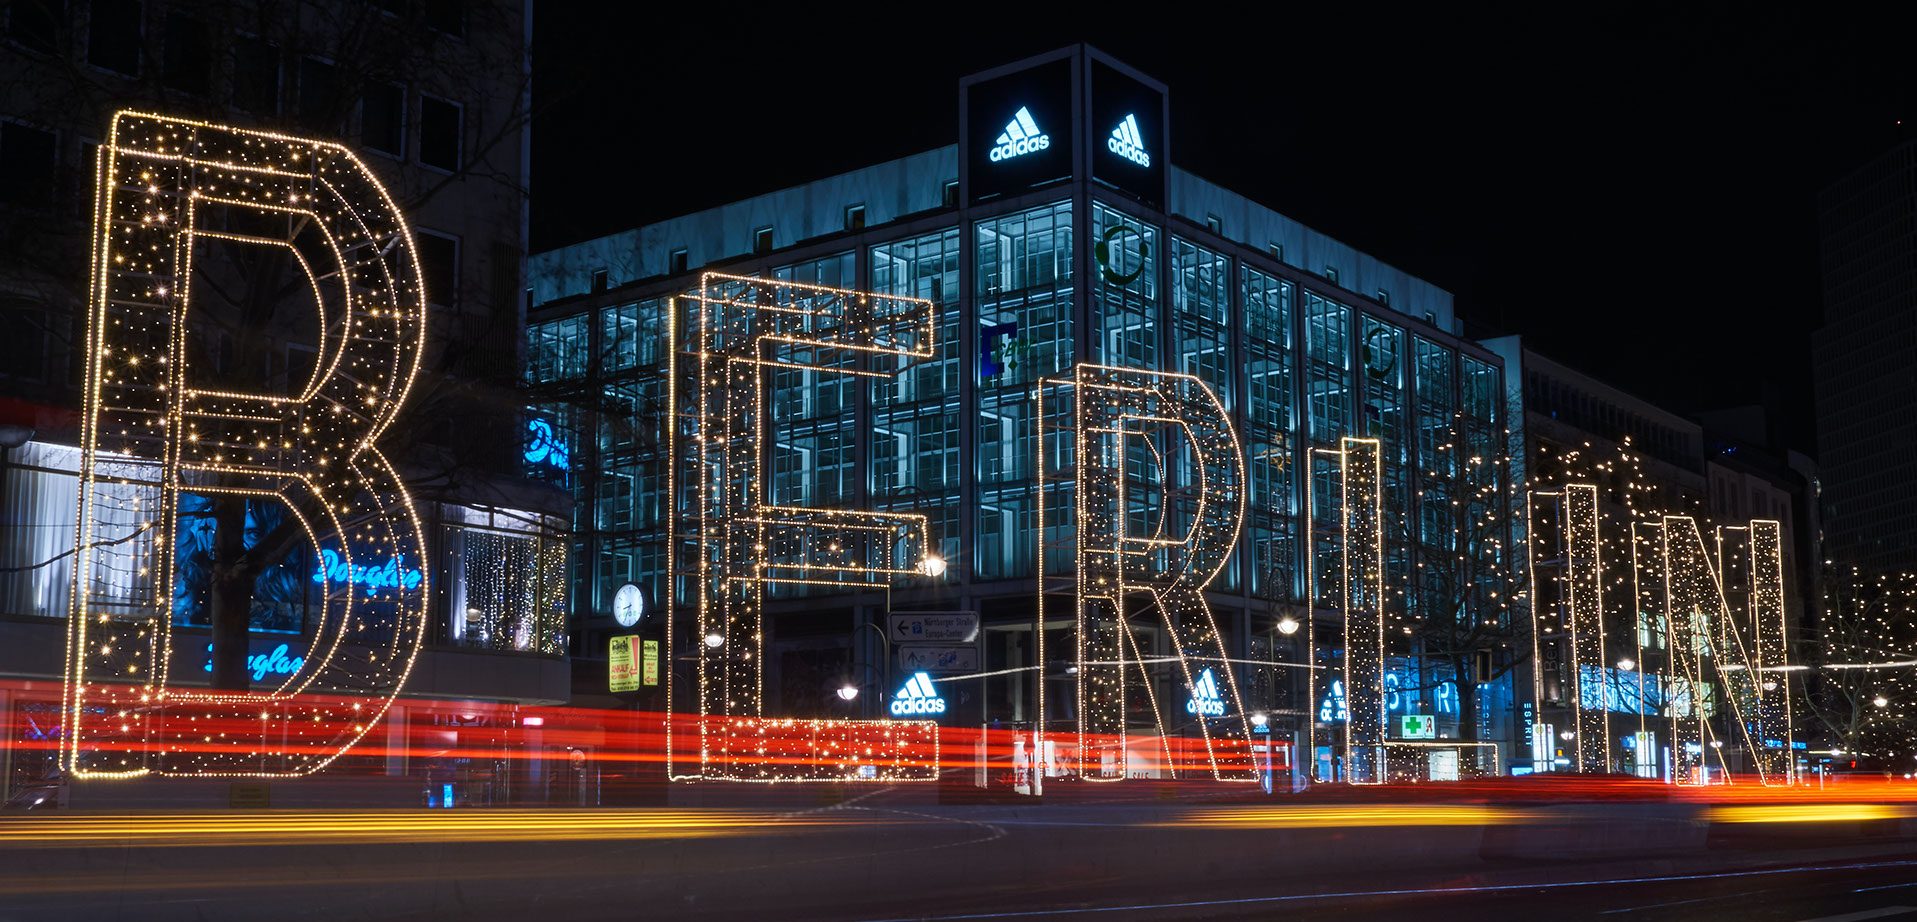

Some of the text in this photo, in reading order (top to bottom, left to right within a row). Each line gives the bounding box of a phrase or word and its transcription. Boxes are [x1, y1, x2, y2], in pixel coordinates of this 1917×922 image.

[990, 134, 1050, 162] adidas
[1108, 137, 1150, 168] adidas
[59, 109, 1796, 786] BERLIN
[312, 549, 422, 596] Douglas
[891, 697, 946, 715] adidas
[1523, 702, 1533, 747] ESPRIT
